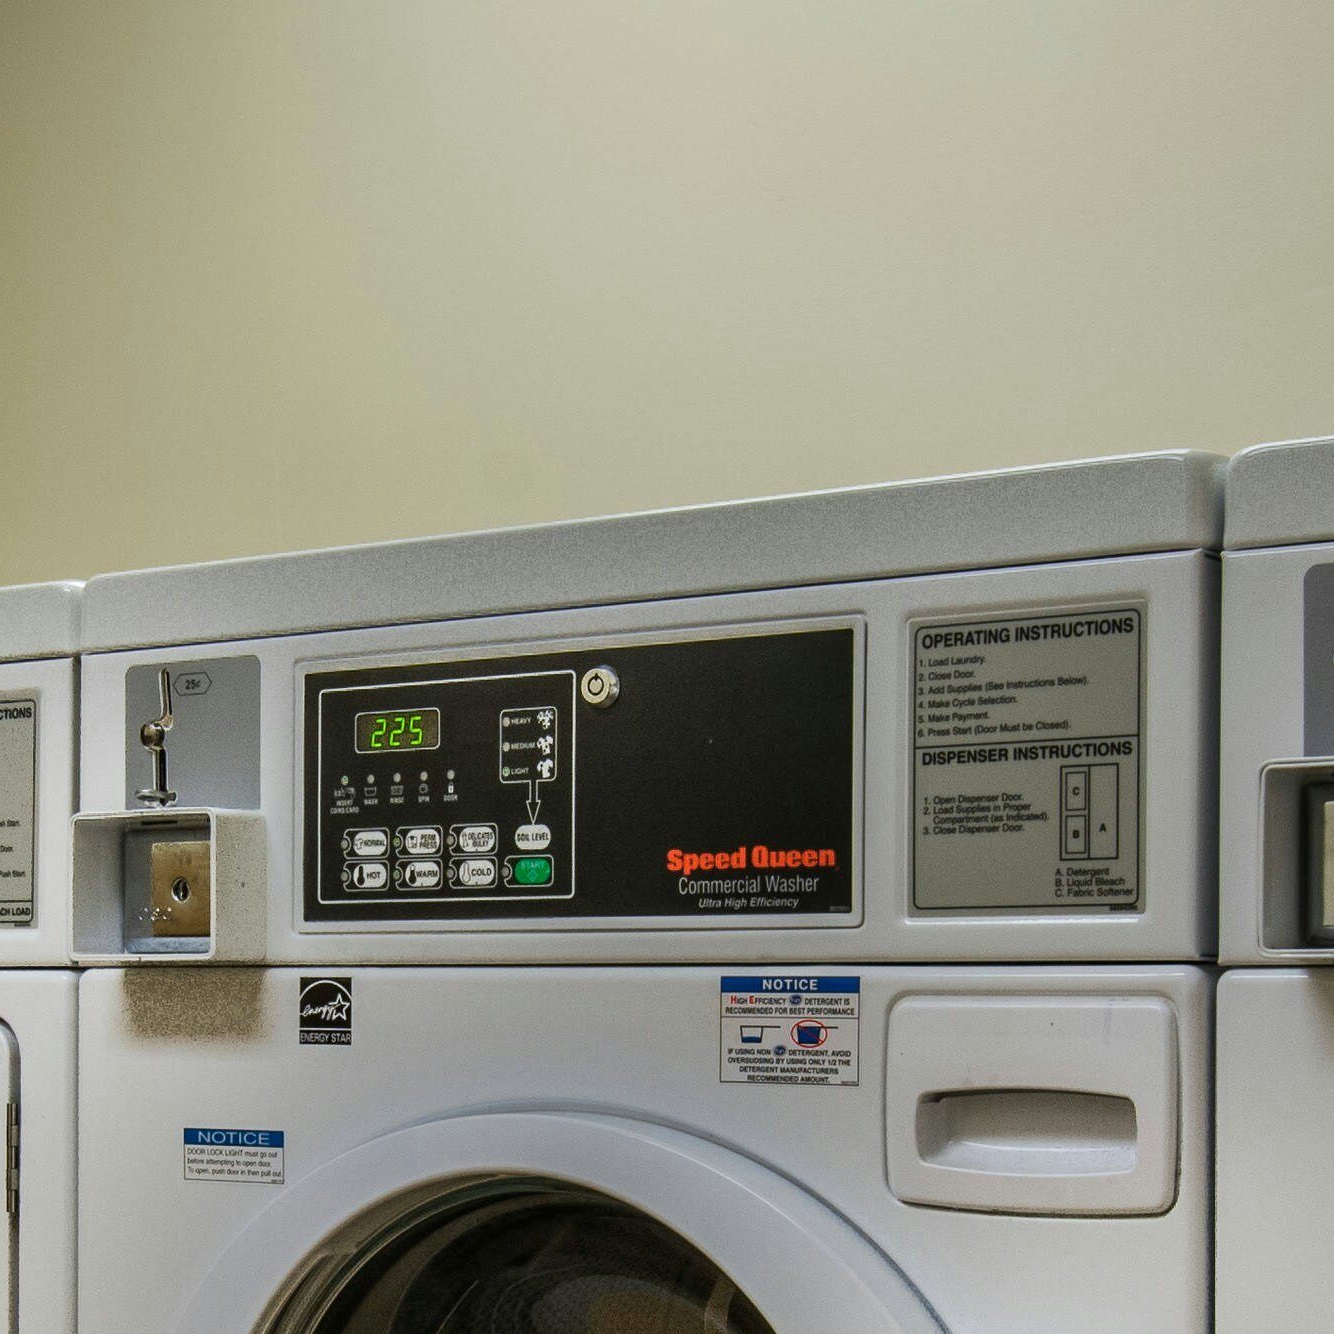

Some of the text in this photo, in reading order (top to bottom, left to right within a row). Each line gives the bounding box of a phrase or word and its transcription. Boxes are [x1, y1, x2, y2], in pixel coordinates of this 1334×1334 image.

[922, 617, 1133, 649] OPERATING INSTRUCTIONS
[919, 659, 926, 667] 1.
[928, 658, 949, 667] Load
[919, 670, 975, 681] 2. Close Door.
[918, 688, 926, 696] 3.
[928, 686, 944, 694] Add
[947, 683, 982, 695] Supplies
[985, 682, 1004, 692] (See
[1006, 678, 1055, 689] Instructions
[928, 714, 949, 722] Make
[371, 715, 423, 748] 225
[511, 742, 535, 750] MEDIUM
[922, 741, 1133, 766] DISPENSER INSTRUCTIONS
[1072, 787, 1079, 795] C
[1099, 824, 1107, 832] A
[517, 832, 549, 841] SOIL LEVEL
[1072, 830, 1079, 838] B
[363, 839, 385, 847] NORMAL
[419, 840, 437, 848] PRESS
[667, 846, 835, 875] Speed Queen
[367, 872, 381, 880] HOT
[417, 870, 439, 878] WARM
[471, 868, 491, 876] COLD
[1055, 868, 1109, 878] A. Detergent
[679, 875, 819, 896] Commercial Washer
[1055, 877, 1125, 889] B. Liquid Bleach
[1055, 887, 1133, 897] C. Fabric Softener
[699, 897, 799, 910] Ultra High Efficiency
[12, 907, 31, 916] LOAD
[763, 979, 818, 990] NOTICE
[301, 1032, 351, 1042] ENERGY STAR
[197, 1130, 270, 1146] NOTICE
